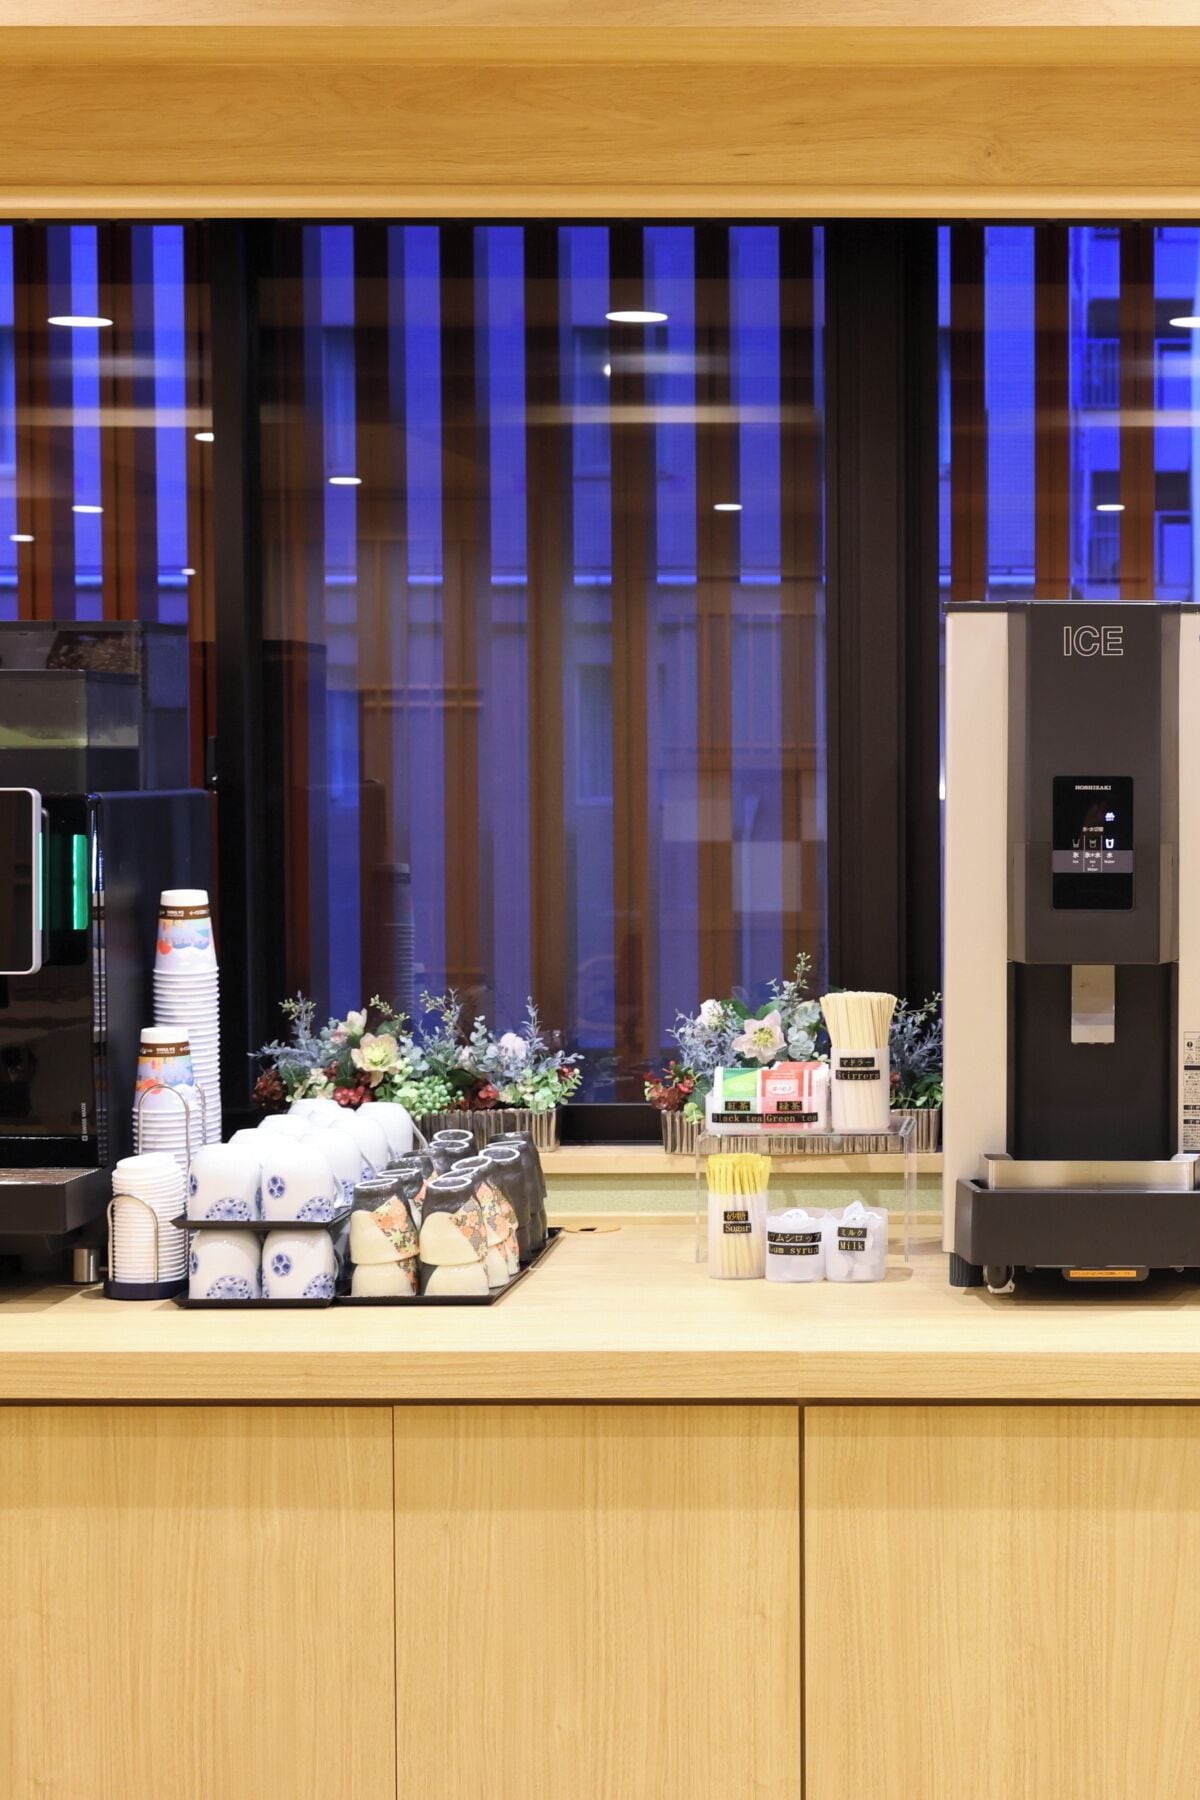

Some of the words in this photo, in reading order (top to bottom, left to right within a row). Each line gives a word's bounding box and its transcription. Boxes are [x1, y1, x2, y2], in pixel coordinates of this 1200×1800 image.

[1064, 625, 1124, 656] ICE
[836, 1071, 880, 1079] Stirrers
[726, 1102, 749, 1110] 紅茶
[778, 1101, 801, 1110] 緑茶
[746, 1114, 763, 1122] tea
[766, 1113, 796, 1122] Green
[802, 1113, 818, 1121] tea
[725, 1223, 751, 1232] Sugar
[840, 1229, 864, 1237] ミルク
[840, 1240, 864, 1250] Milk
